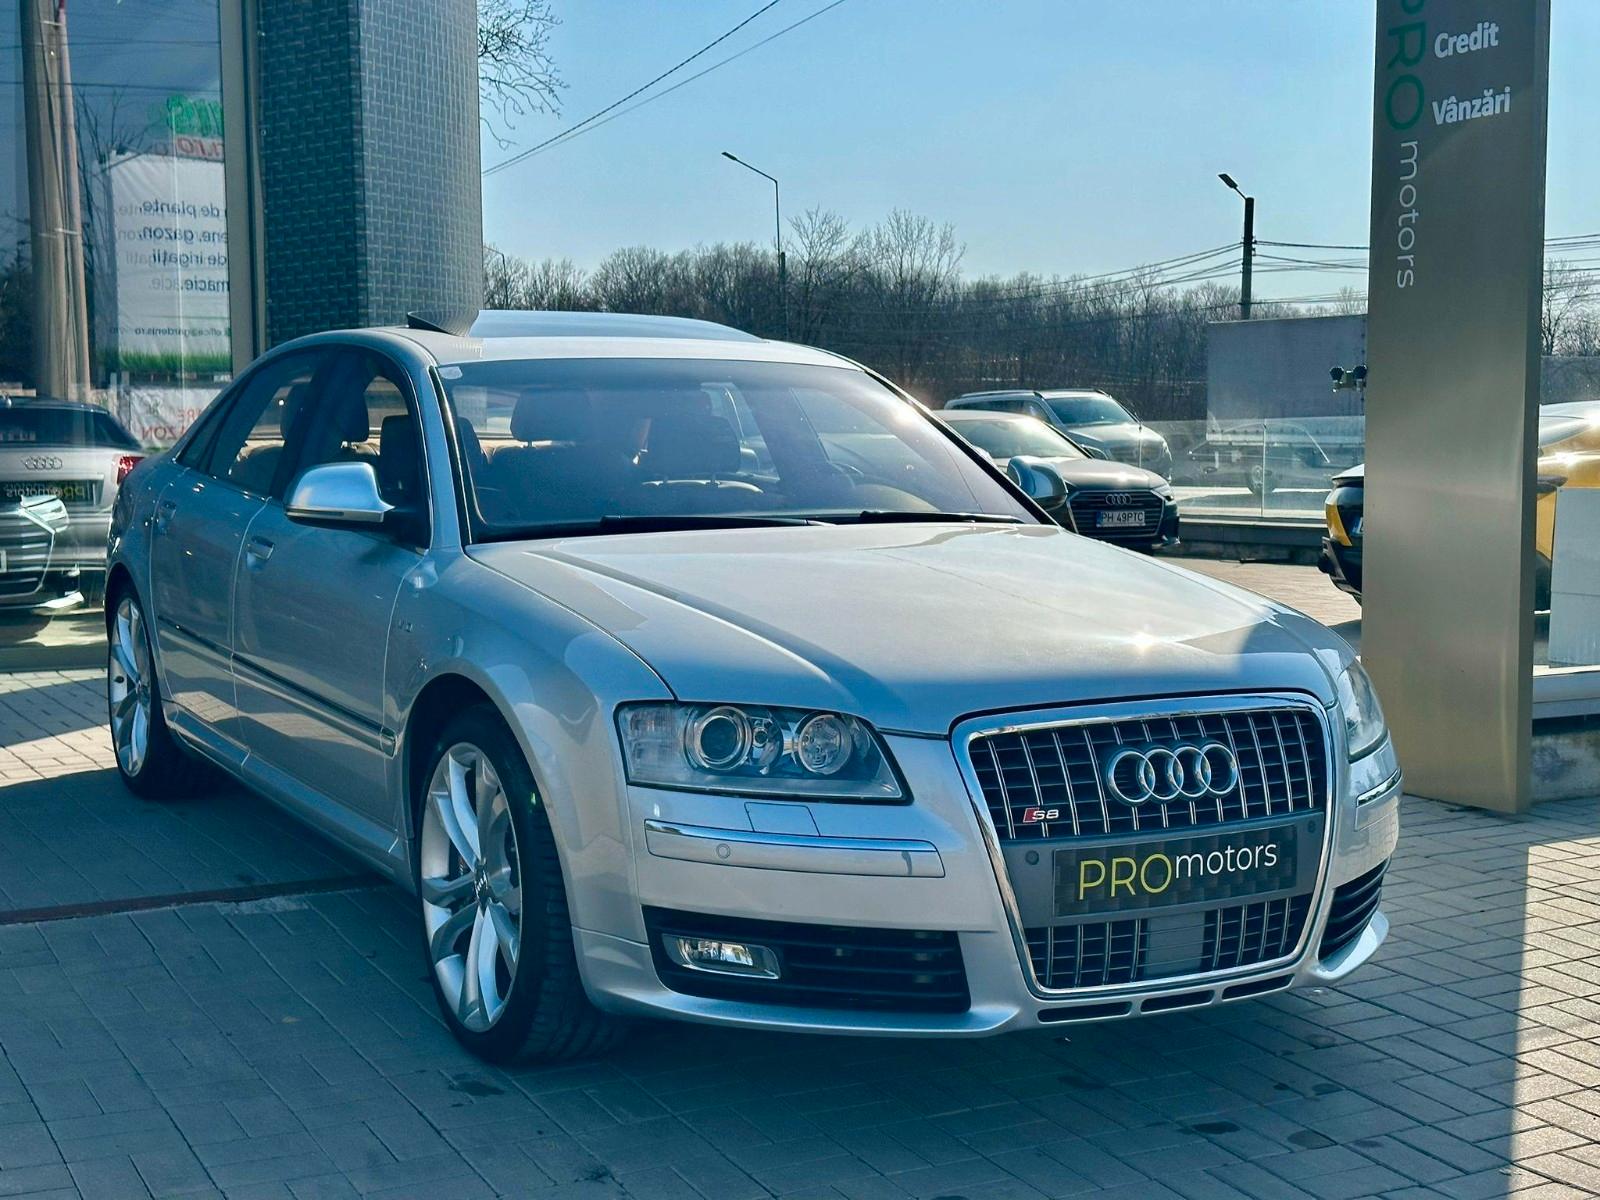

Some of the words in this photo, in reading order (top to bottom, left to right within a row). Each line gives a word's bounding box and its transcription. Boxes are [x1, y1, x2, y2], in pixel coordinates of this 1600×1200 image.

[1434, 21, 1499, 58] Credit
[1431, 86, 1511, 126] Vânzări
[1032, 809, 1059, 820] S8
